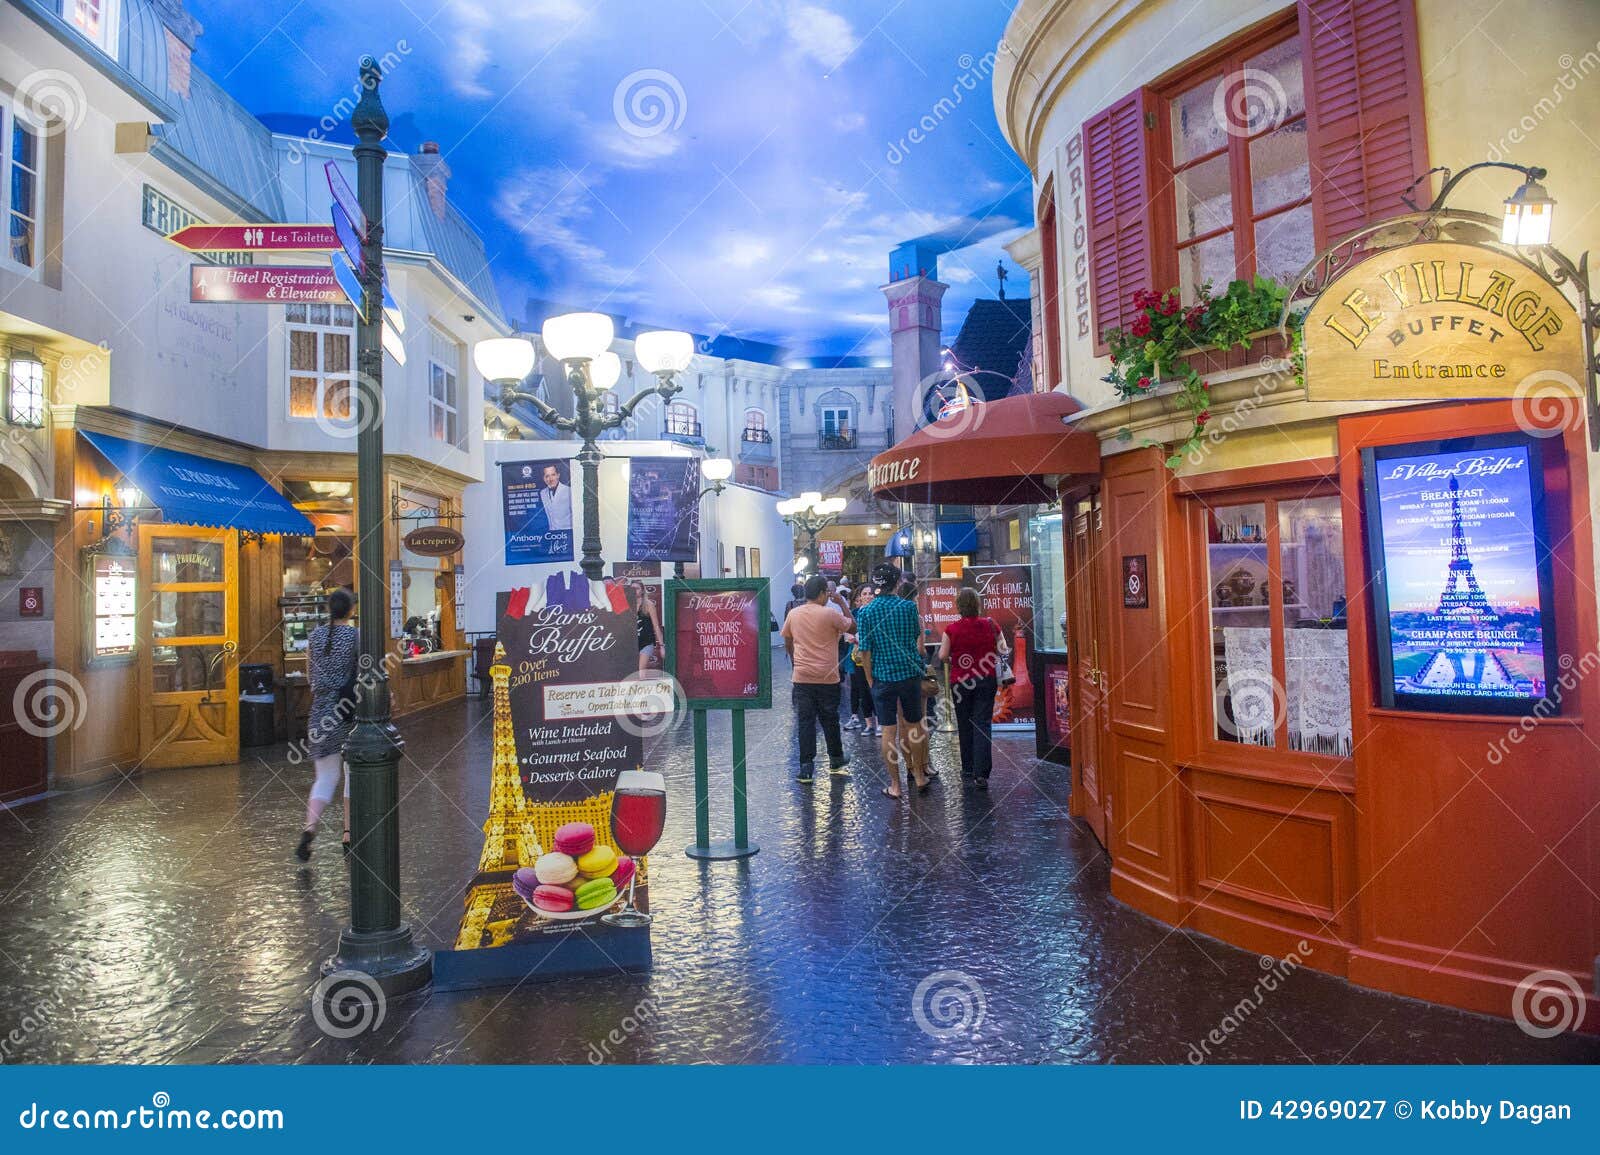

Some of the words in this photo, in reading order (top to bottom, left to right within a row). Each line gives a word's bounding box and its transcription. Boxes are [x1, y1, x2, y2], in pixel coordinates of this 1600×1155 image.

[271, 231, 288, 243] Les
[291, 229, 334, 243] Toilettes
[1066, 133, 1089, 340] BRIOCHE
[262, 270, 334, 287] Registration
[266, 287, 277, 299] &
[280, 287, 337, 299] Elevators
[1325, 288, 1386, 350] LE
[1380, 260, 1563, 352] VILLAGE
[1387, 315, 1504, 347] BUFFET
[1373, 359, 1506, 379] Entrance
[1398, 462, 1460, 481] Village
[1454, 456, 1525, 477] Buffet
[1420, 488, 1484, 500] BREAKFAST
[510, 534, 542, 543] Anthony
[544, 532, 568, 540] Cools
[1440, 537, 1472, 546] LUNCH
[926, 587, 935, 595] $5
[935, 586, 957, 596] Bloody
[975, 572, 1001, 596] TAKE
[1002, 583, 1022, 595] HOME
[1024, 583, 1030, 594] A
[983, 598, 1000, 609] PART
[1003, 597, 1012, 609] OF
[533, 604, 598, 626] Paris
[696, 622, 717, 634] SEVEN
[1411, 630, 1475, 639] CHAMPAGNE
[1477, 630, 1518, 639] BRUNCH
[528, 625, 617, 664] Buffet
[699, 634, 731, 646] DIAMOND
[732, 633, 739, 645] &
[703, 647, 736, 658] PLATINUM
[519, 657, 549, 674] Over
[703, 659, 737, 671] ENTRANCE
[511, 674, 532, 687] 200
[533, 667, 560, 683] Items
[547, 688, 586, 701] Reserve
[588, 690, 595, 699] a
[597, 686, 625, 698] Table
[628, 684, 652, 696] Now
[656, 682, 671, 694] On
[528, 726, 559, 740] Wine
[562, 722, 612, 738] Included
[529, 751, 580, 765] Gourmet
[583, 746, 628, 763] Seafood
[529, 771, 575, 784] Desserts
[577, 766, 617, 780] Galore
